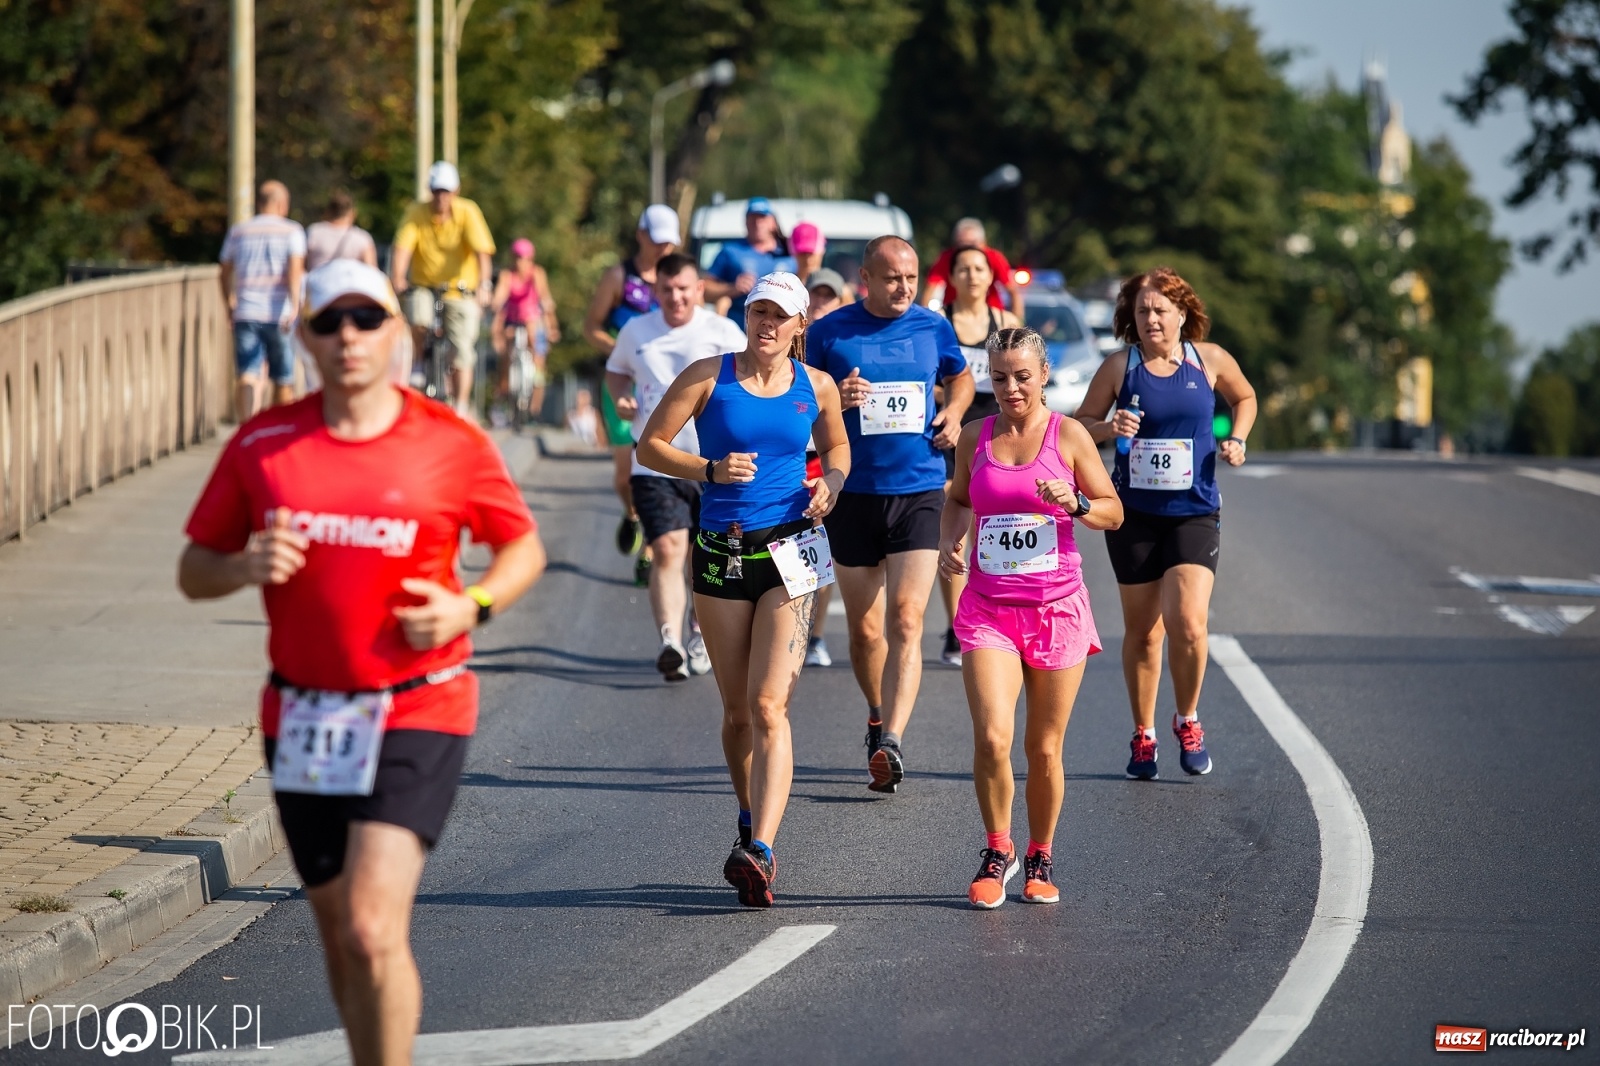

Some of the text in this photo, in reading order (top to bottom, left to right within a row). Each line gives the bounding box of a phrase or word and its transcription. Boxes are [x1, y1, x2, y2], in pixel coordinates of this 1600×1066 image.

[887, 396, 907, 412] 49
[1150, 453, 1171, 469] 48
[264, 508, 419, 551] CATHLON
[999, 530, 1037, 551] 460
[800, 546, 818, 568] 30
